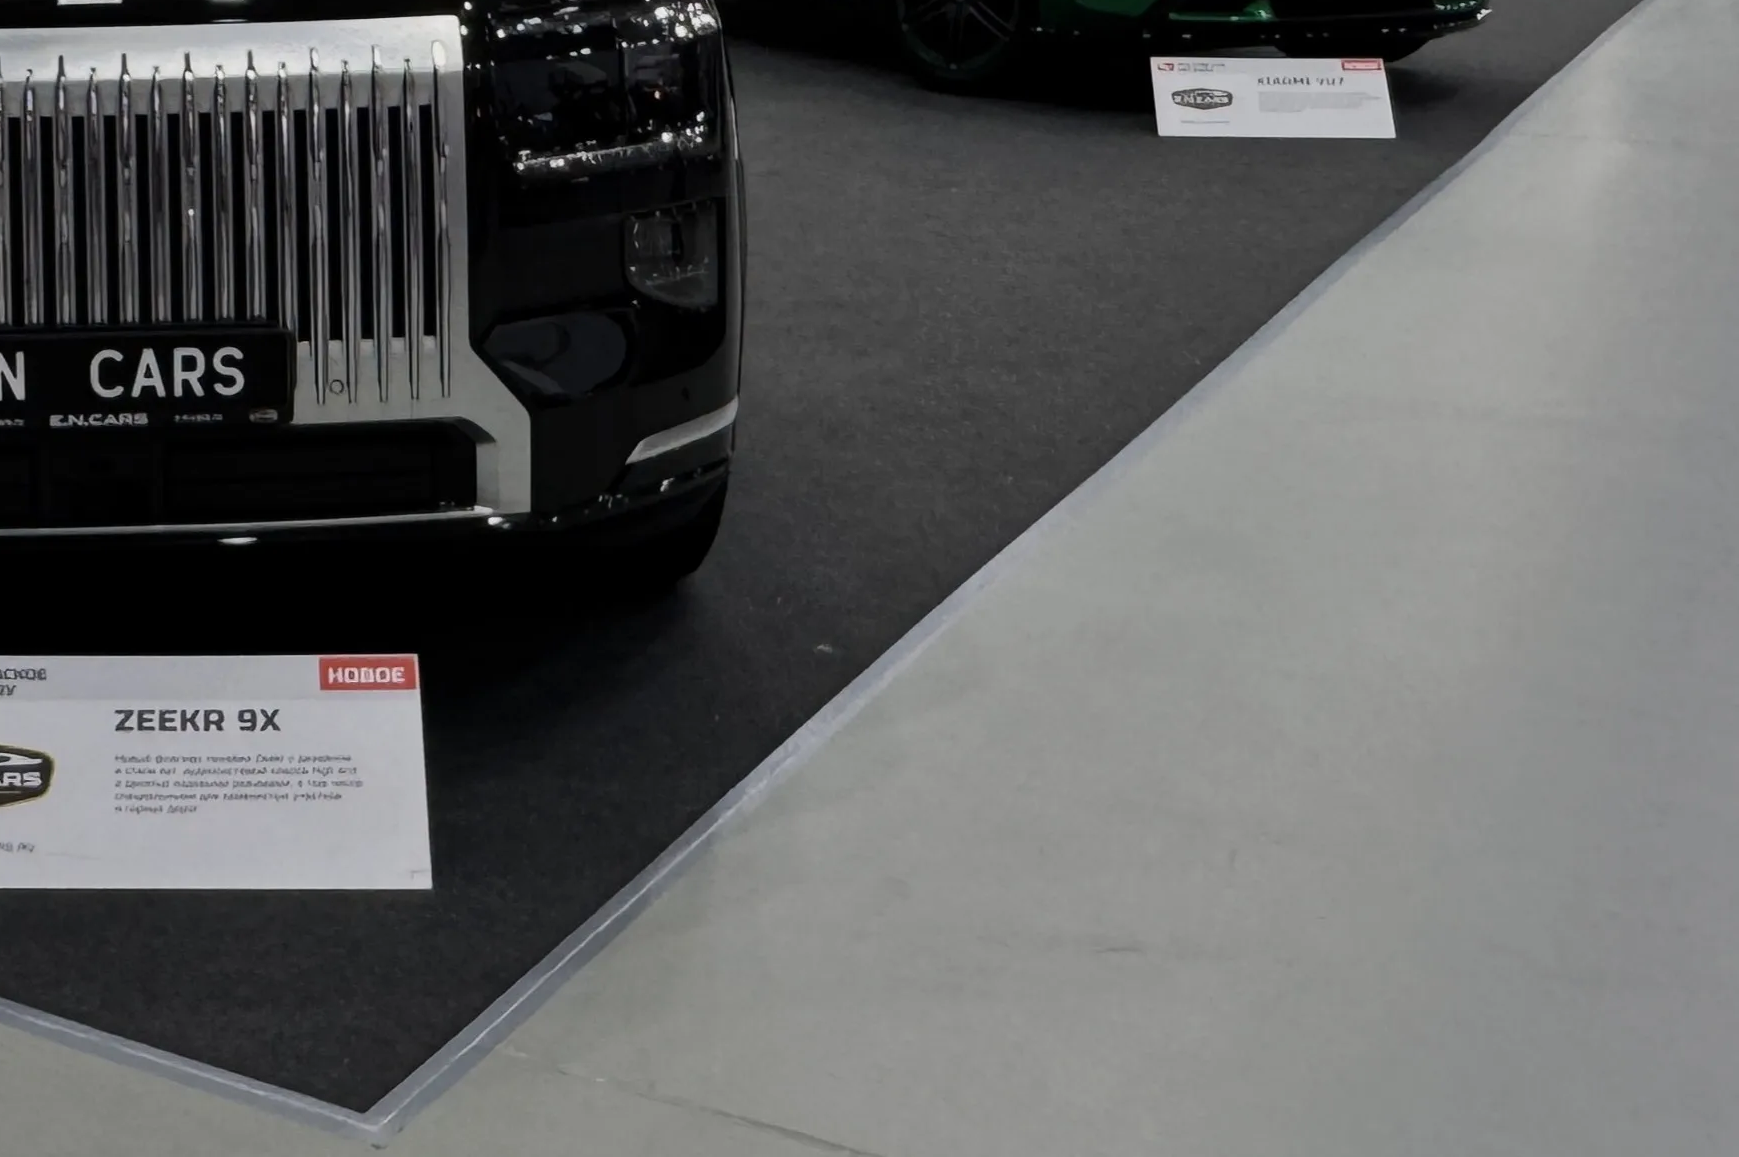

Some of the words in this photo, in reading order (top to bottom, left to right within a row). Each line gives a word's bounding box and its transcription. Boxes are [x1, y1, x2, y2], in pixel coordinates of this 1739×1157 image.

[89, 346, 245, 399] CARS
[114, 709, 225, 732] ZEEKR
[237, 709, 281, 732] 9X
